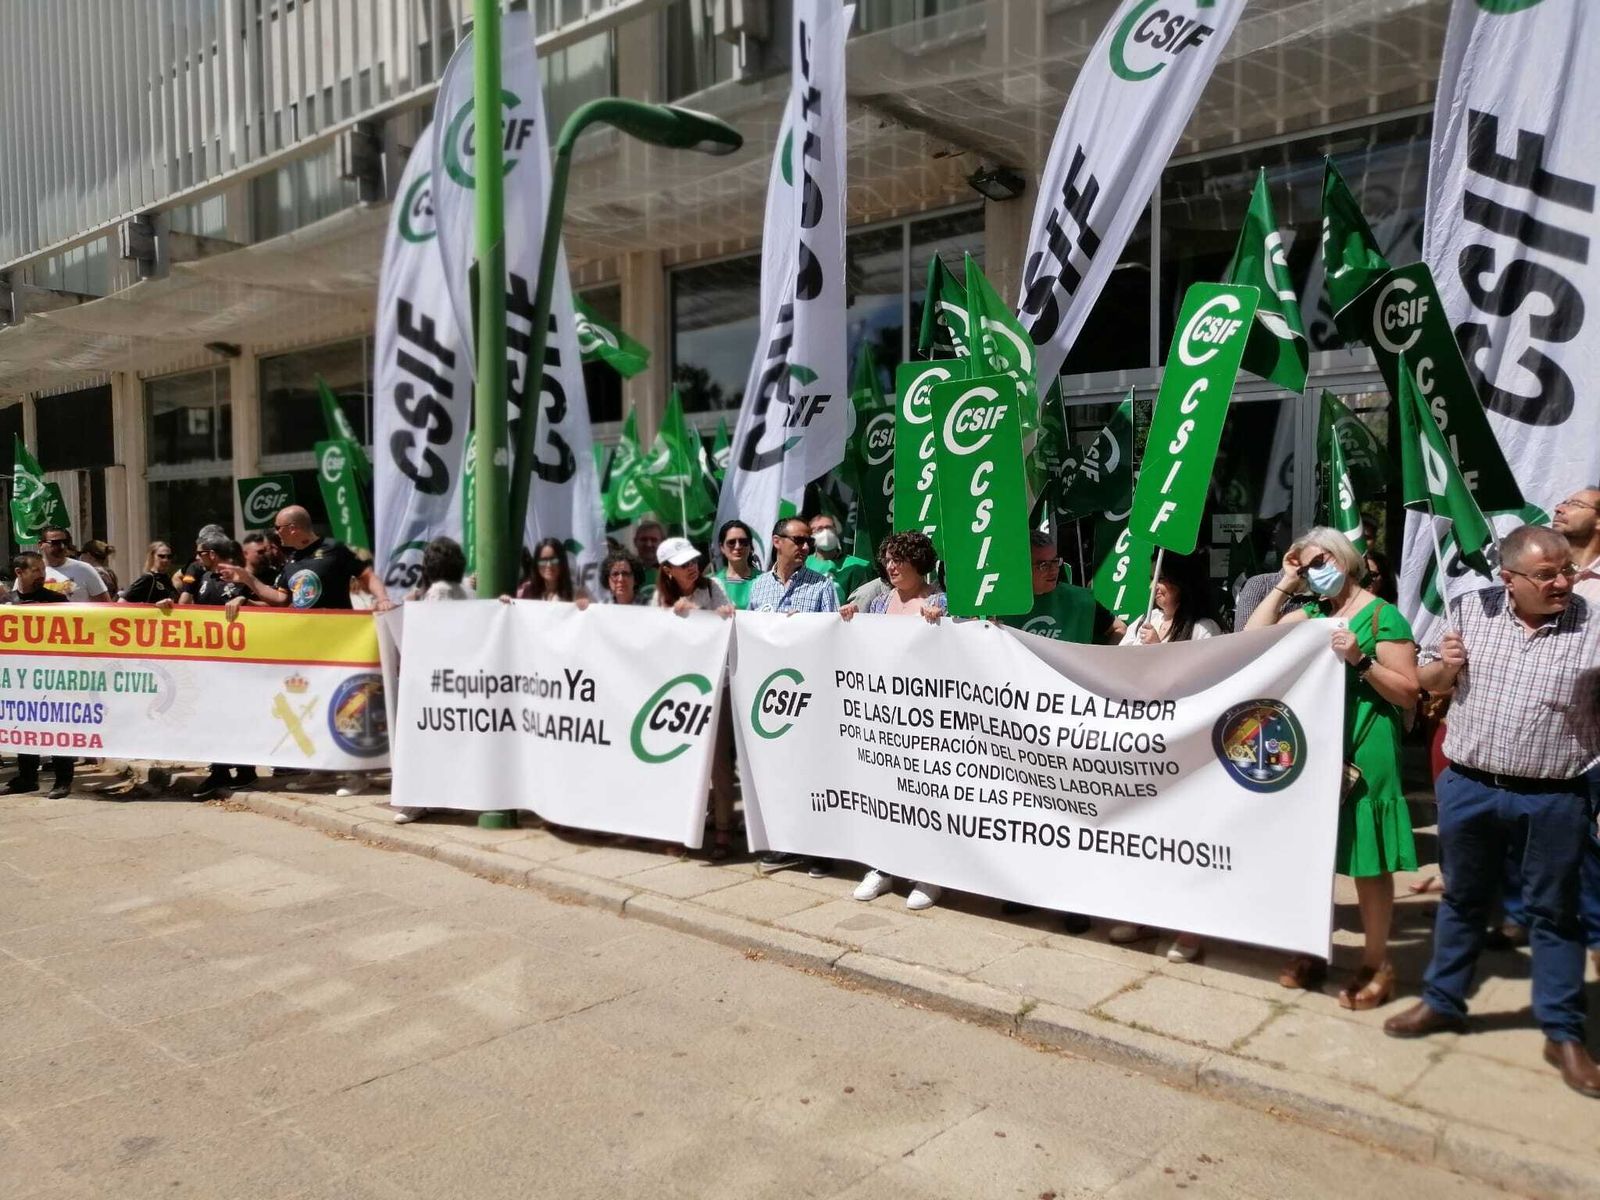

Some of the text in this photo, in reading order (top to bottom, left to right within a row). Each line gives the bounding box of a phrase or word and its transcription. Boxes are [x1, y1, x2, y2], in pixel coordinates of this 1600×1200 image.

[1133, 9, 1215, 56] CSIF
[1016, 142, 1101, 346] SIF
[1454, 107, 1596, 427] CSIF
[1191, 314, 1244, 346] CSIF
[1384, 295, 1429, 330] CSIF
[390, 297, 455, 495] CSIF
[868, 427, 895, 449] CSI
[955, 404, 1008, 434] CSIF
[1150, 377, 1206, 534] CSIF
[252, 493, 289, 511] CSIF
[970, 460, 1000, 607] CSIF
[1112, 527, 1133, 621] CSI
[109, 617, 247, 651] SUELDO
[16, 668, 28, 690] Y
[33, 668, 109, 692] GUARDIA
[113, 671, 158, 694] CIVIL
[431, 668, 596, 702] #EquiparacionYa
[762, 688, 812, 718] CSIF
[835, 670, 1177, 722] POR LA DIGNIFICACIÓN DE LA LABOR
[0, 726, 104, 749] CÓRDOBA
[417, 706, 611, 746] JUSTICIA SALARIAL
[843, 698, 1167, 754] DE LAS/LOS EMPLEADOS PÚBLICOS
[839, 723, 1180, 776] POR LA RECUPERACIÓN DEL PODER ADQUISITIVO
[857, 747, 1158, 798] MEJORA DE LAS CONDICIONES LABORALES
[897, 776, 1099, 818] MEJORA DE LAS PENSIONES
[810, 788, 1233, 872] ¡¡¡DEFENDEMOS NUESTROS DERECHOS!!!
